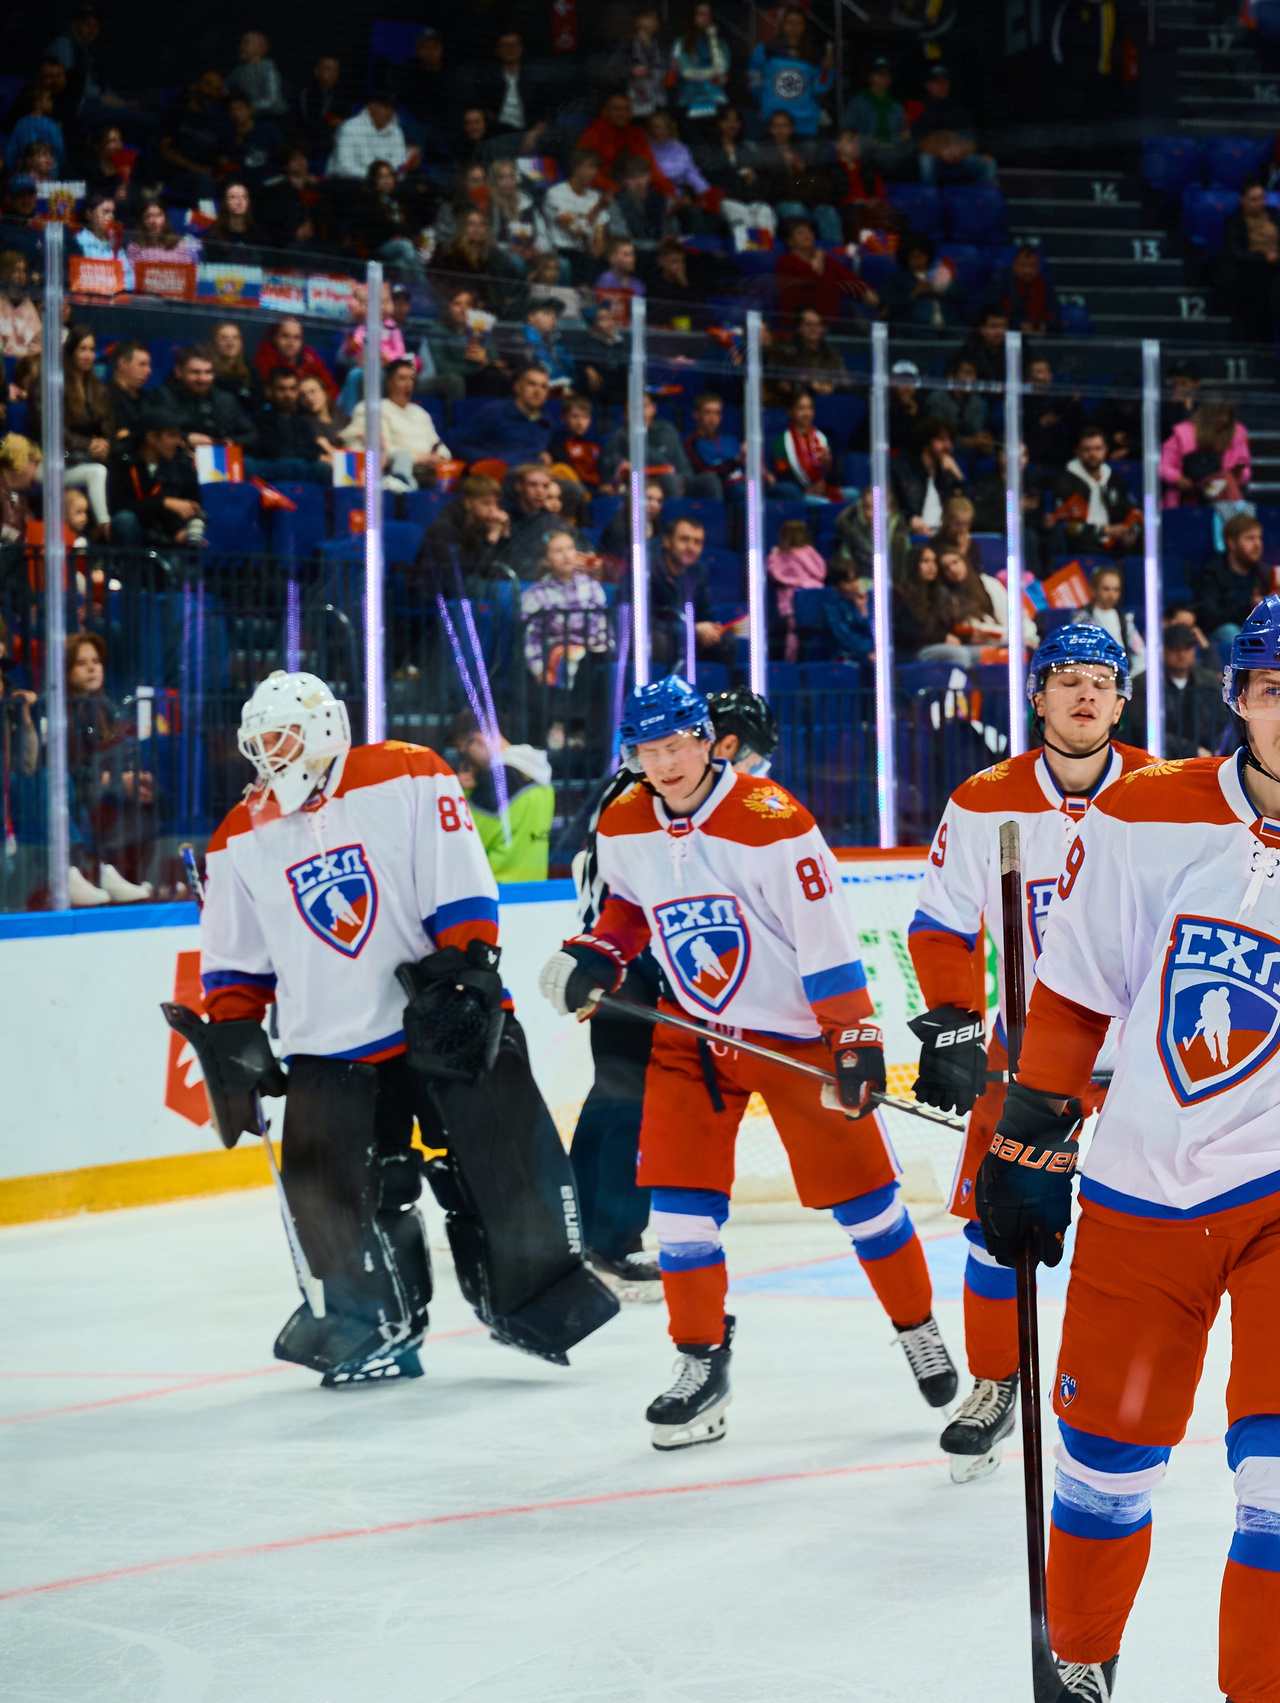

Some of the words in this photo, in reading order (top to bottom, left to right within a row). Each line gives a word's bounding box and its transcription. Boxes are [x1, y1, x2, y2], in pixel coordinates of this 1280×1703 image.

[1132, 238, 1162, 263] 13
[1178, 295, 1207, 320] 12
[1226, 357, 1248, 383] 11
[1068, 637, 1097, 645] CCM
[640, 714, 665, 727] CCM
[291, 848, 366, 894] СХЛ
[656, 899, 741, 938] СХЛ
